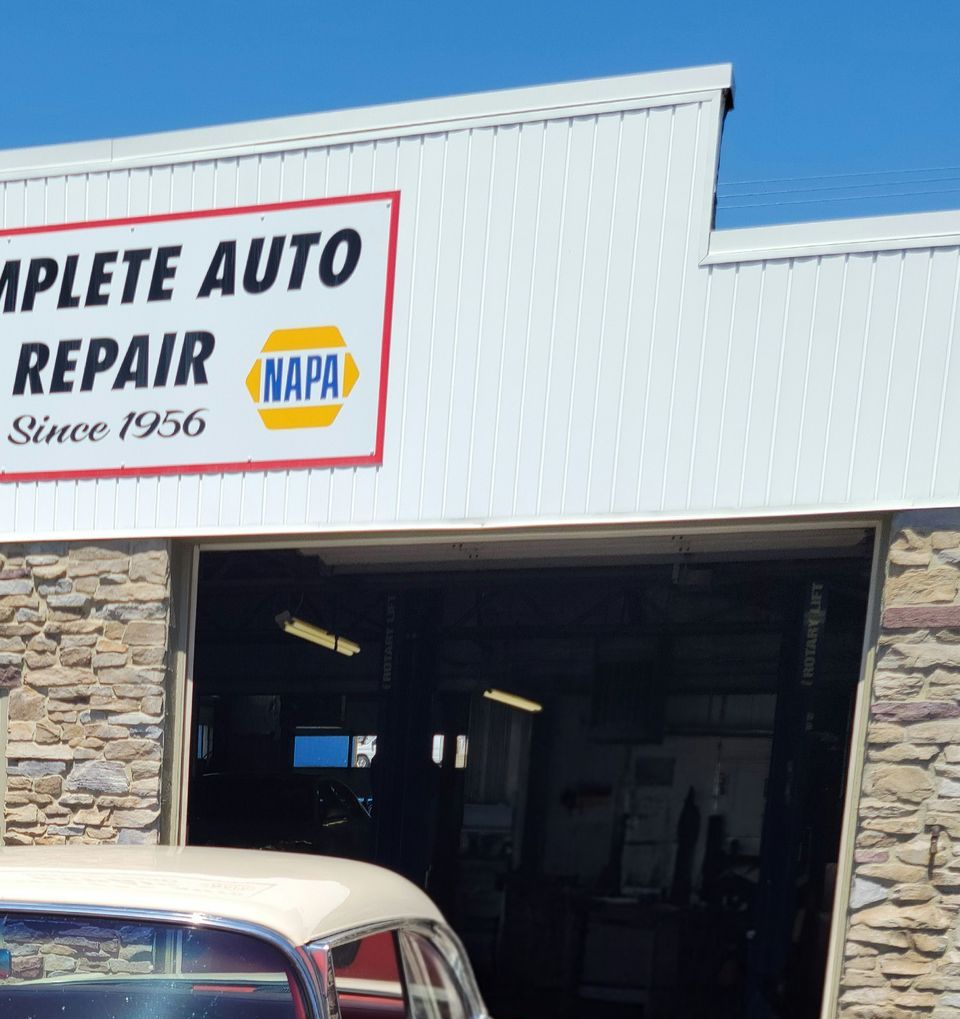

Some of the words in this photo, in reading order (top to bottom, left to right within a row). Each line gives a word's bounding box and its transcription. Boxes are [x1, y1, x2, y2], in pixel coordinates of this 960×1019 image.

[196, 228, 362, 298] AUTO
[12, 330, 216, 396] REPAIR
[262, 353, 341, 403] NAPA
[6, 415, 110, 446] Since
[117, 408, 207, 441] 1956
[810, 582, 823, 613] LIFT
[803, 618, 819, 679] ROTARY
